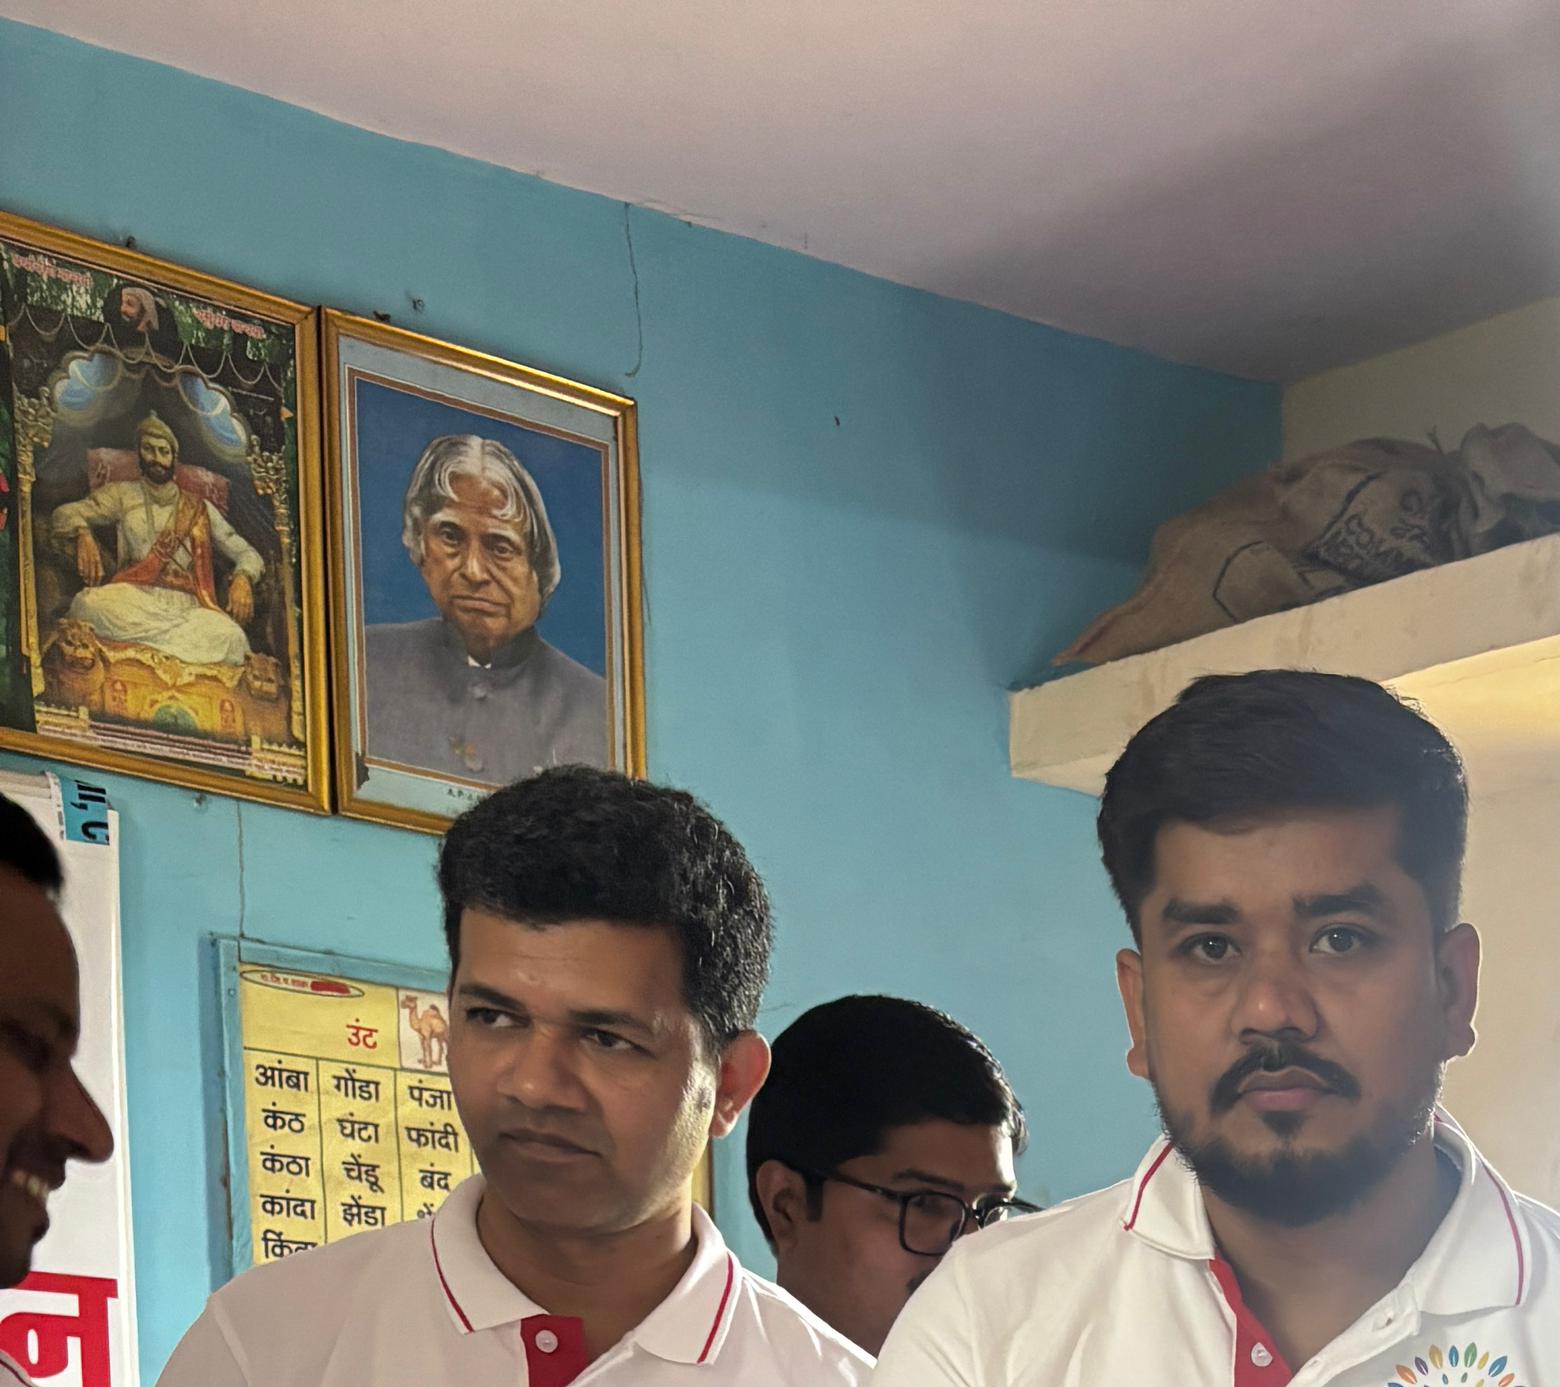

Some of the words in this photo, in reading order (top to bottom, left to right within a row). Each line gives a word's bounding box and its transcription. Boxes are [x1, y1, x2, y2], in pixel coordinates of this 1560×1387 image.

[346, 1017, 379, 1050] उंट
[255, 1059, 309, 1093] आंबा
[333, 1068, 381, 1103] गोंडा
[408, 1079, 453, 1111] पंजा
[262, 1101, 306, 1134] कंठ
[336, 1112, 380, 1144] घंटा
[405, 1121, 459, 1153] फांदी
[260, 1144, 311, 1178] कंठा
[342, 1153, 385, 1194] चेंडू
[259, 1188, 317, 1220] कांदा
[341, 1194, 387, 1228] झेंडा
